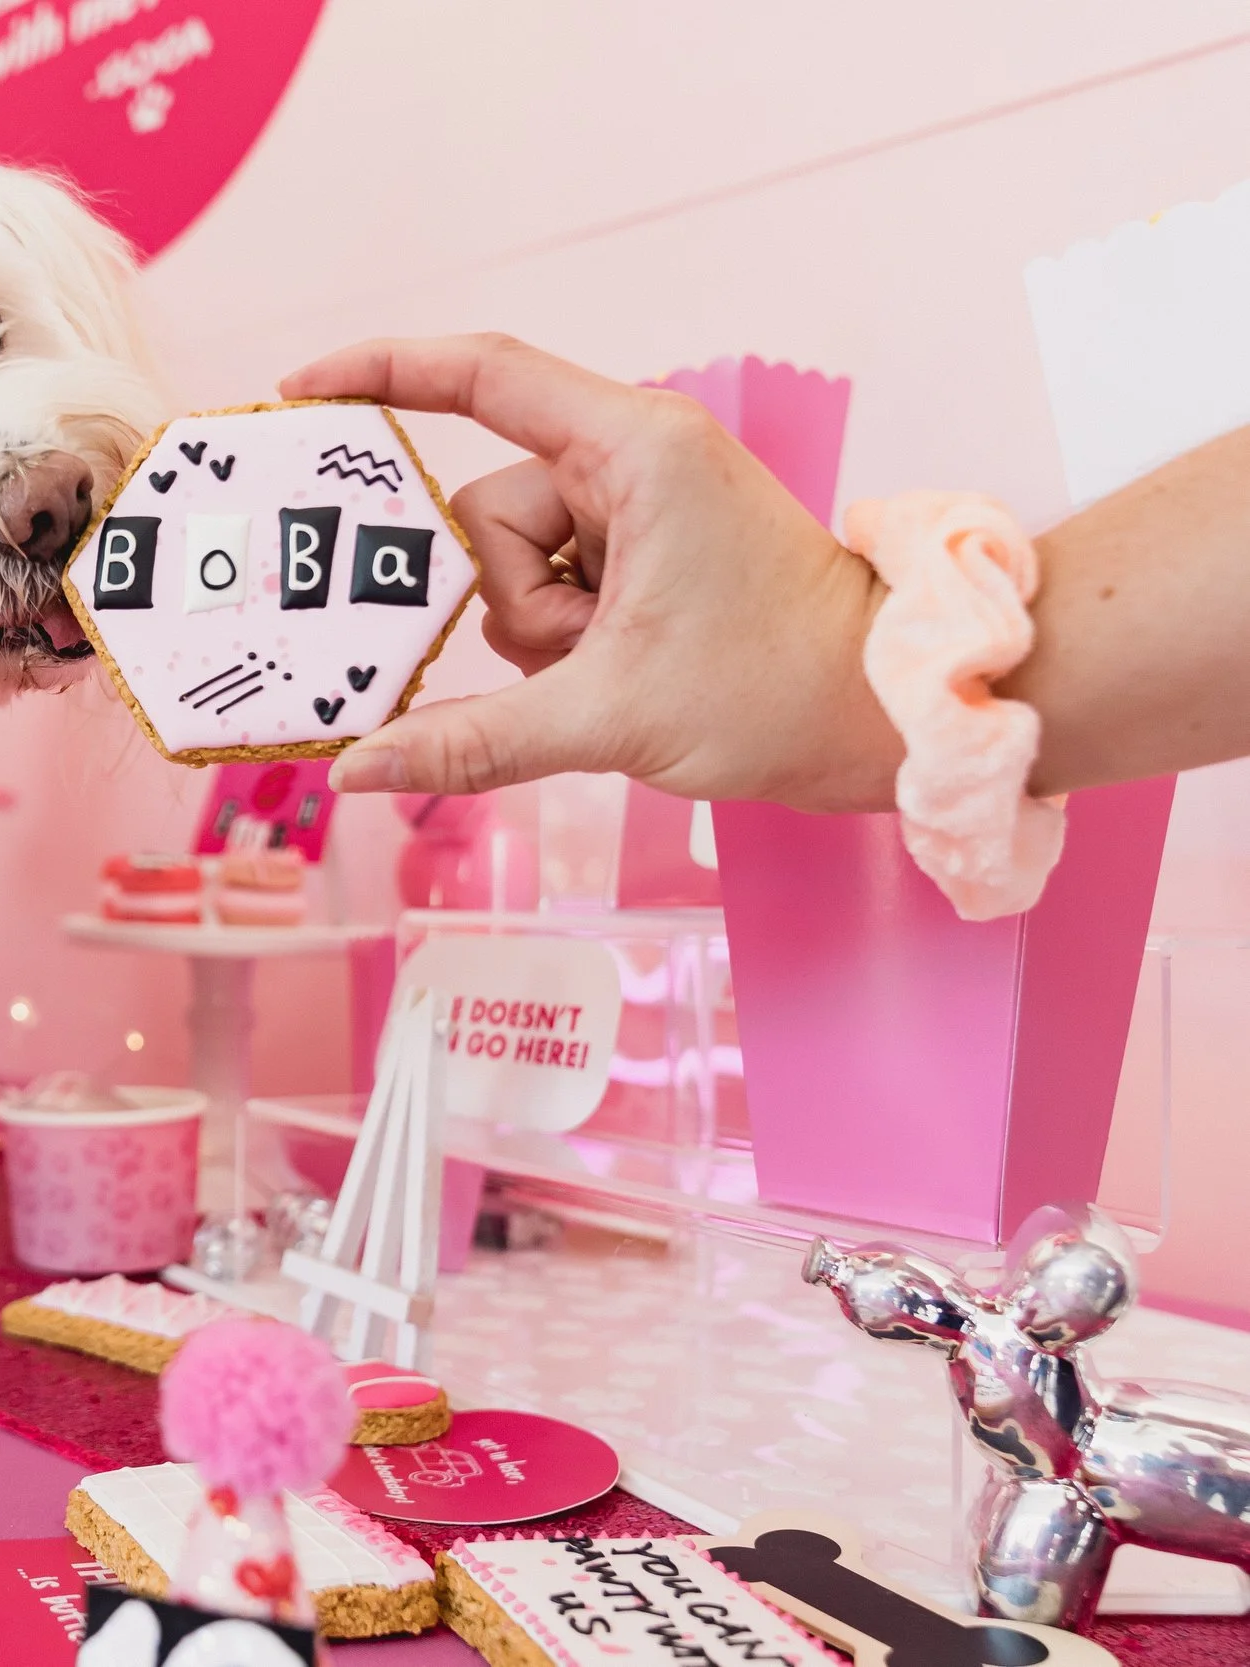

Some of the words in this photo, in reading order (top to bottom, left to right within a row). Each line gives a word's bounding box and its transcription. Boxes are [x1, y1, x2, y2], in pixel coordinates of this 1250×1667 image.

[470, 998, 582, 1032] DOESN'T
[467, 1031, 507, 1059] GO
[513, 1035, 590, 1070] HERE!
[373, 1464, 417, 1504] barkday!
[548, 1535, 670, 1618] PAWTY
[40, 1593, 88, 1645] butte
[611, 1541, 702, 1599] YOU
[687, 1602, 795, 1667] CAN
